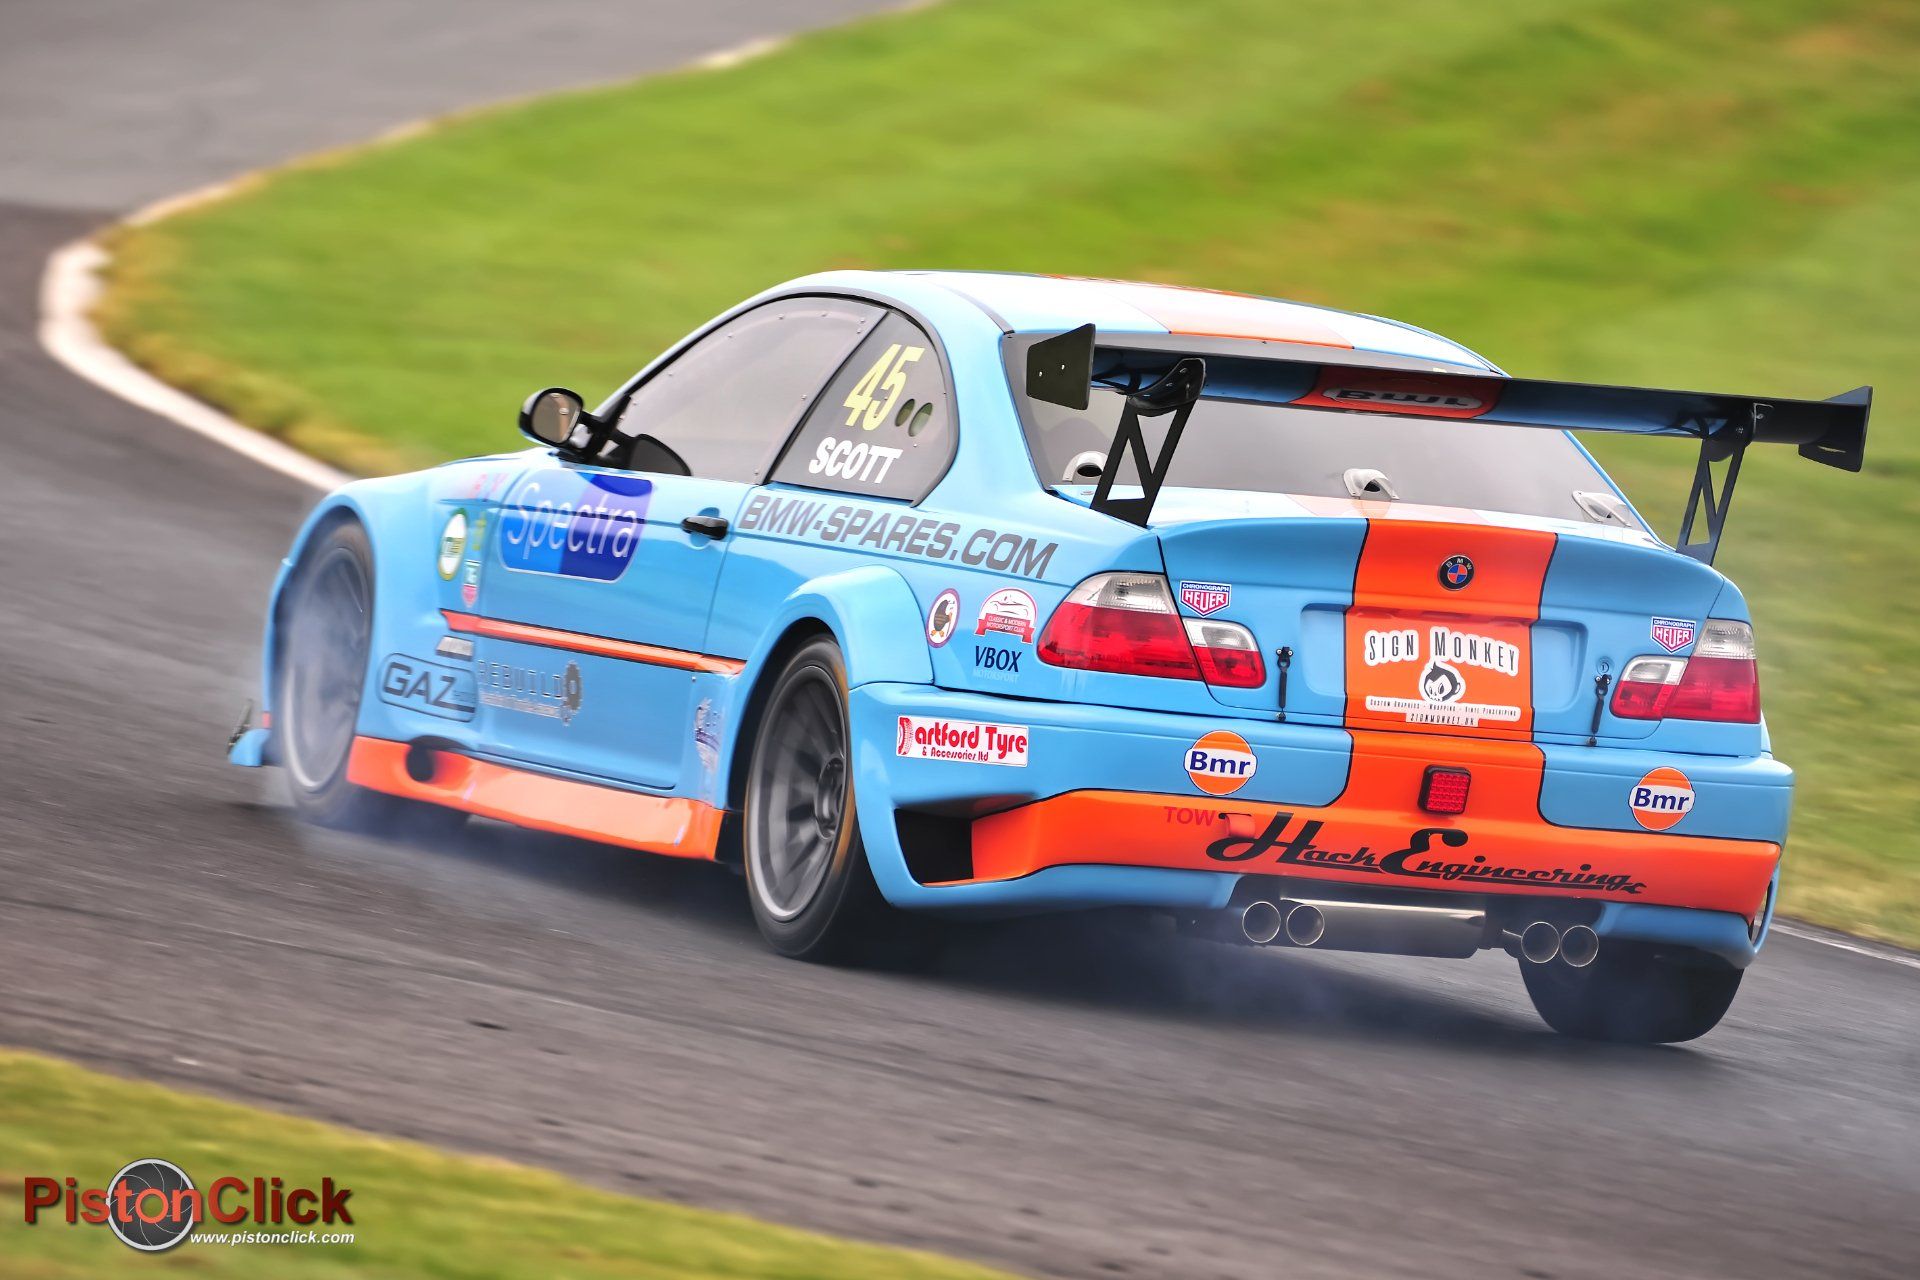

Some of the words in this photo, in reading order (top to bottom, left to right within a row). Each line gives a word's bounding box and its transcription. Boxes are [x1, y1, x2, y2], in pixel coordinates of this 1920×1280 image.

[843, 344, 925, 431] 45
[809, 437, 903, 484] SCOTT
[507, 482, 638, 560] Spectra
[738, 495, 1058, 579] BMW-SPARES.COM
[1446, 558, 1472, 570] BMW
[1182, 583, 1229, 592] CHRONOGRAPH
[1184, 591, 1225, 611] HEUER
[1654, 620, 1694, 628] CHRONOGRAPH
[1656, 627, 1690, 647] HEUER
[975, 645, 1022, 673] VBOX
[1370, 635, 1414, 661] SIGN
[1435, 631, 1515, 671] MONKEY
[383, 661, 475, 714] GAZ
[477, 659, 563, 699] REBUILD
[922, 746, 927, 756] &
[931, 747, 976, 761] Accessories
[985, 726, 1027, 759] Tyre
[1189, 751, 1251, 776] Bmr
[1633, 787, 1689, 811] Bmr
[1164, 806, 1216, 827] TOW
[1206, 811, 1380, 869] Hack
[1379, 828, 1634, 890] Engineering
